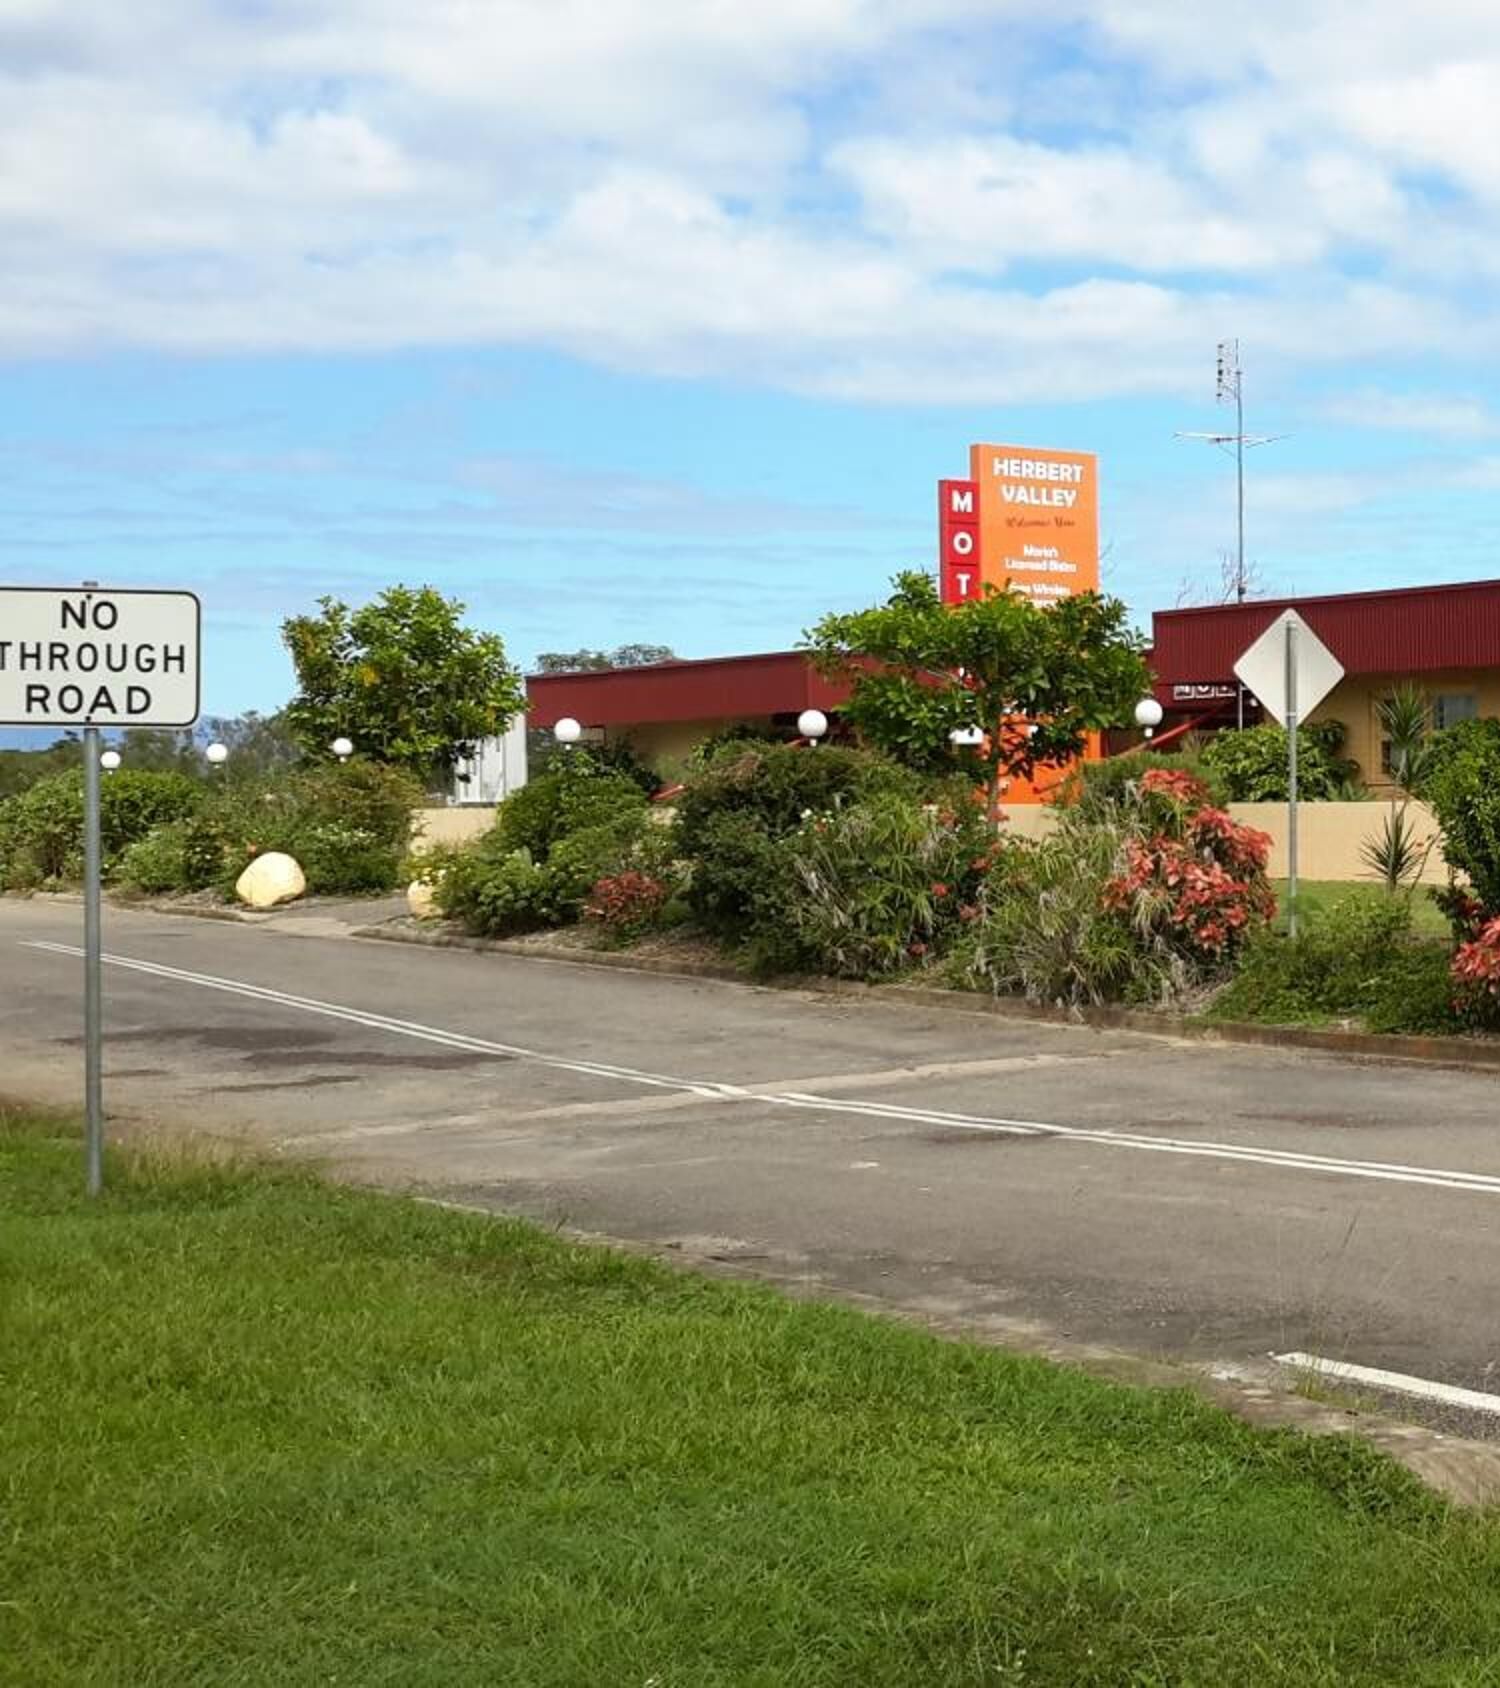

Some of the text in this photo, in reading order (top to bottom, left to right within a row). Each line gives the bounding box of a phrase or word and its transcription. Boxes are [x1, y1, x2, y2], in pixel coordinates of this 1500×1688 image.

[992, 458, 1083, 483] HERBERT
[1001, 484, 1077, 507] VALLEY
[61, 599, 119, 631] NO
[0, 641, 186, 673] THROUGH
[25, 683, 152, 715] ROAD
